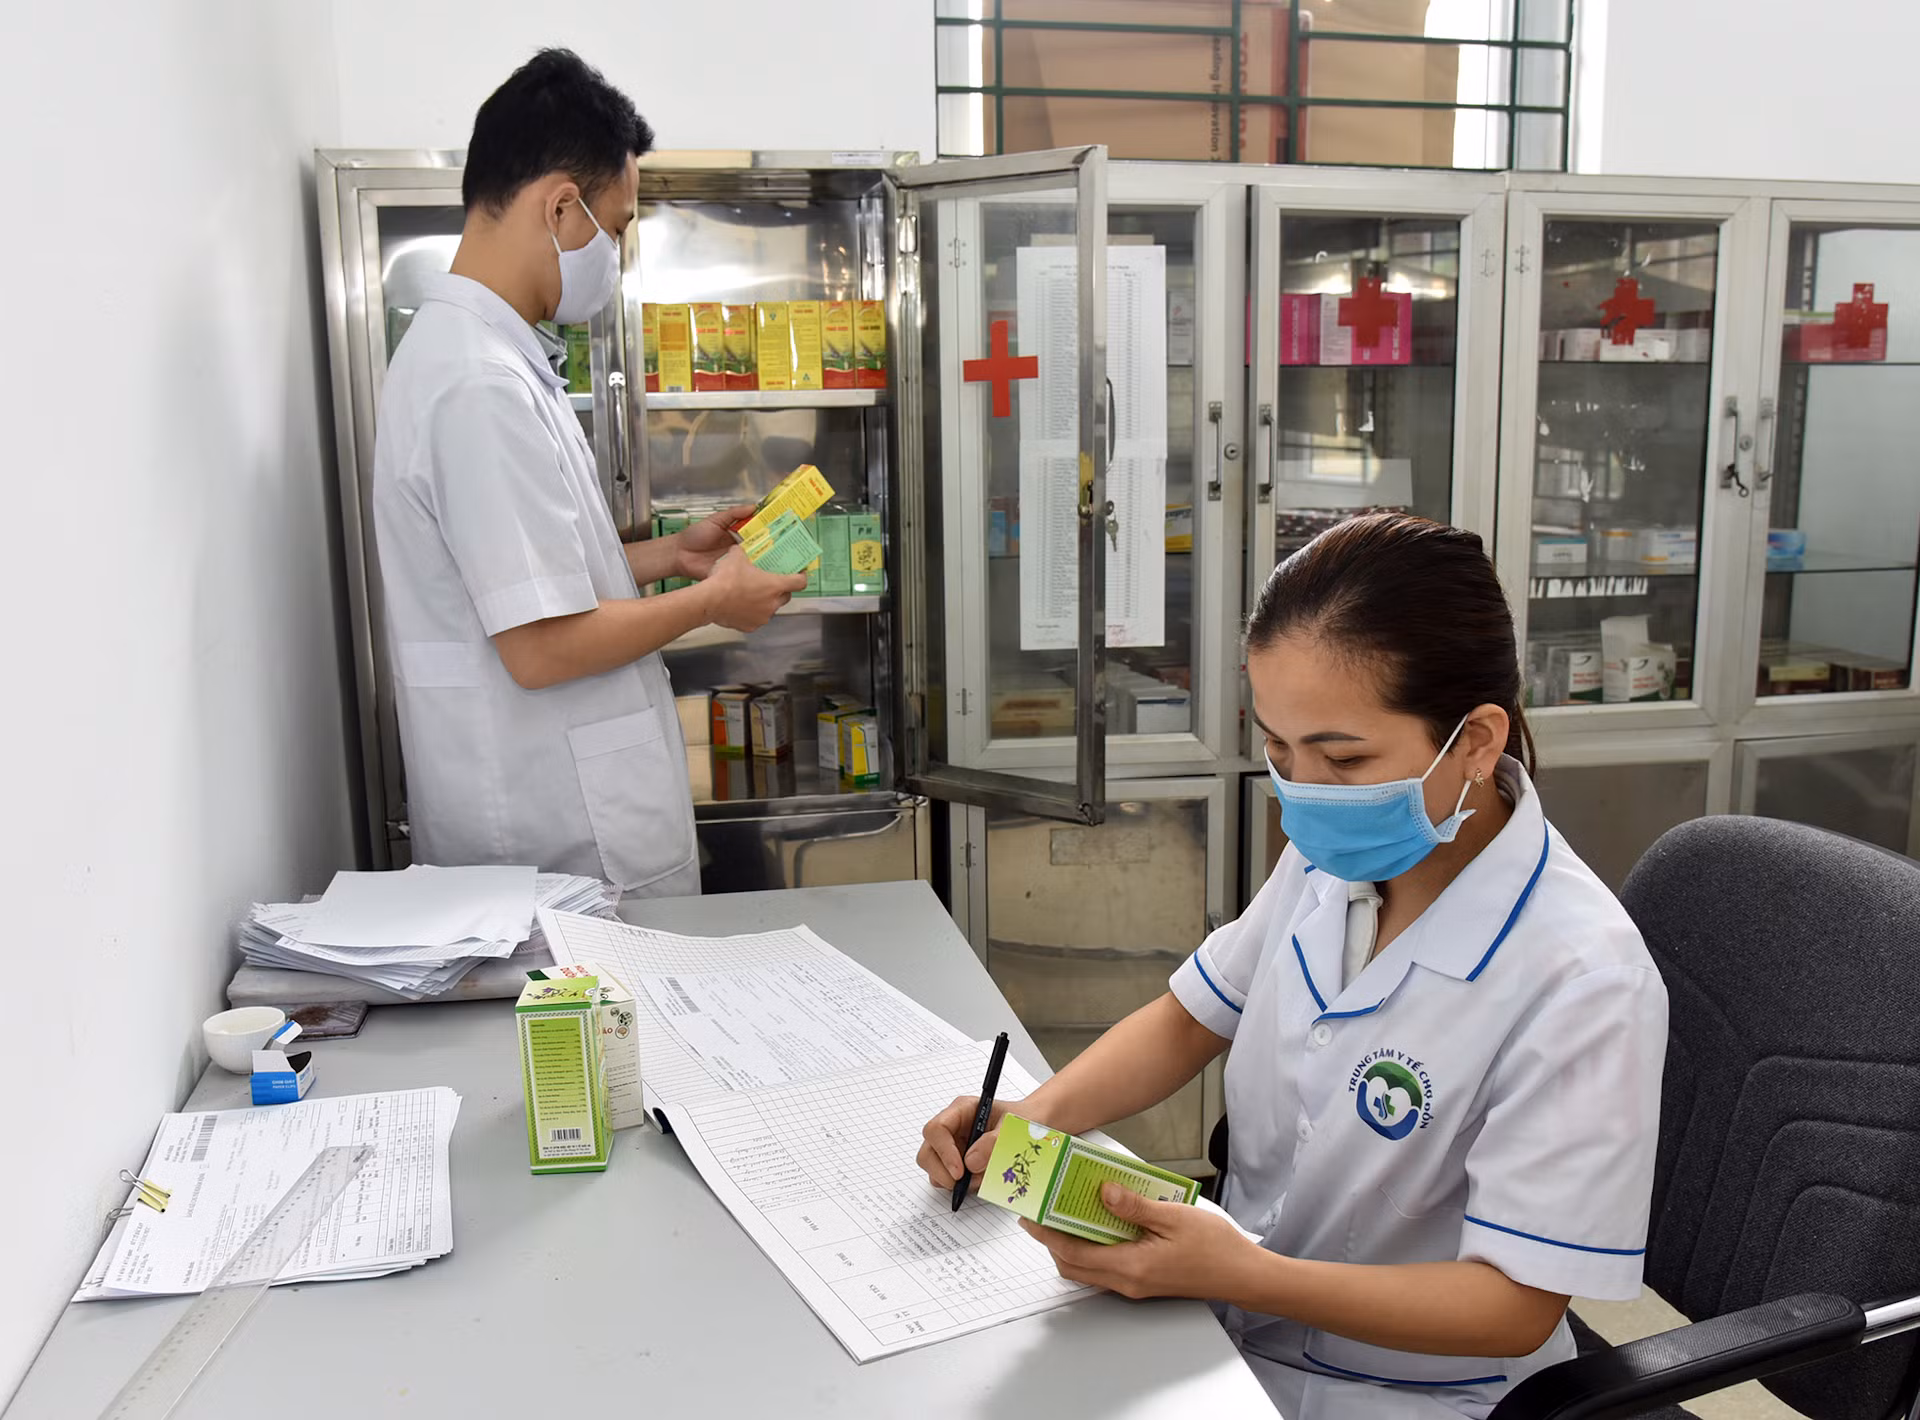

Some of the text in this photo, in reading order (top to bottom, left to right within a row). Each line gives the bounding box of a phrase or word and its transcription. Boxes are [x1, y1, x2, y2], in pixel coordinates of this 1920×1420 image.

[1209, 35, 1222, 152] eading Inovation
[1349, 1055, 1372, 1092] TRUNG
[1373, 1048, 1395, 1060] TÂM
[1397, 1051, 1405, 1061] Y
[1406, 1057, 1424, 1072] TẾ
[1419, 1071, 1433, 1099] CHỢ
